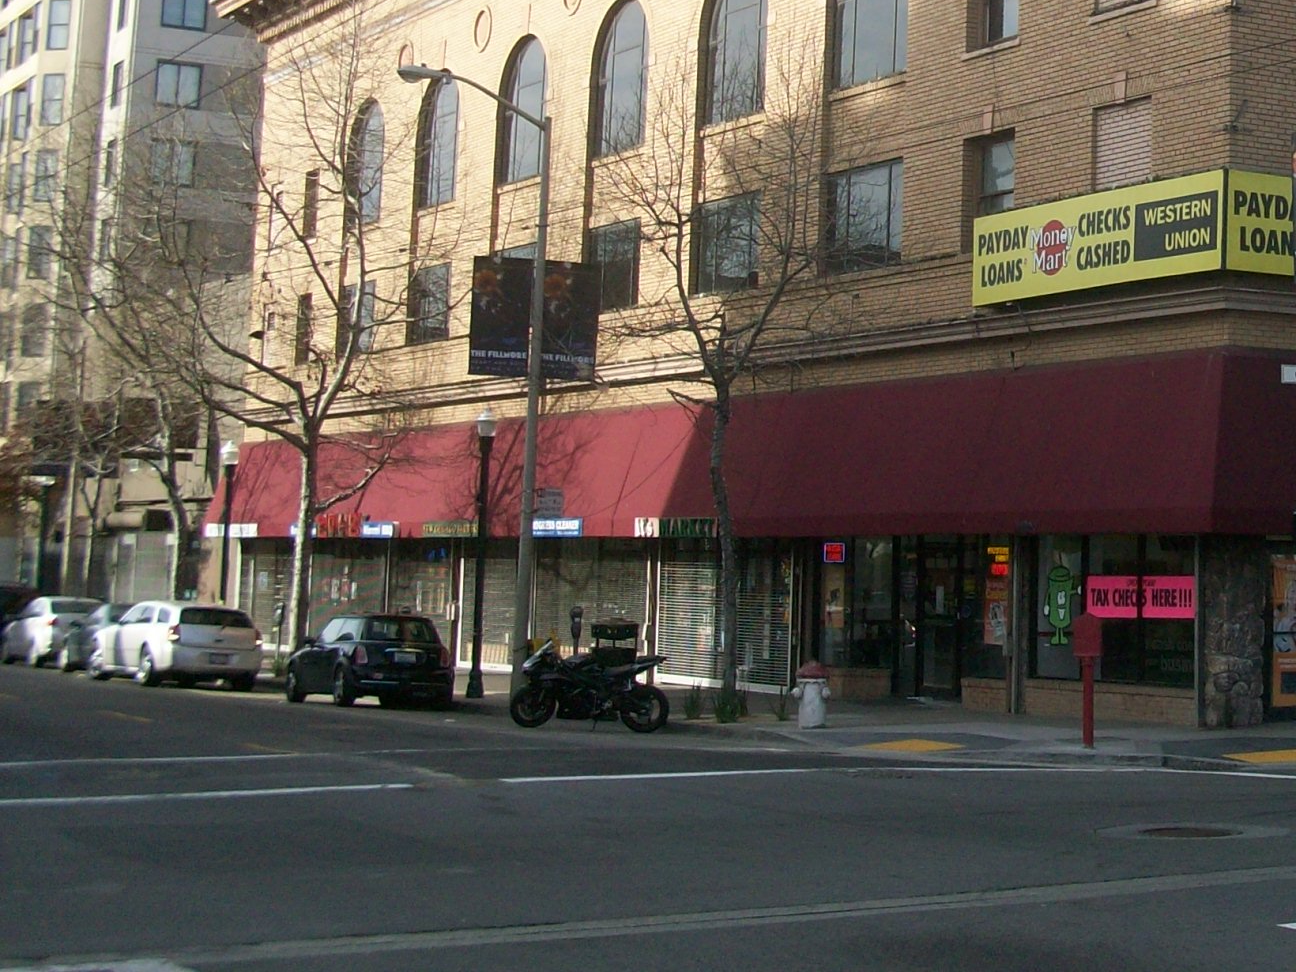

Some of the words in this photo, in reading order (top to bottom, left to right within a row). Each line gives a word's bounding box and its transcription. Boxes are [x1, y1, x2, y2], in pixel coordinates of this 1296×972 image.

[1234, 190, 1294, 221] PAYD
[978, 225, 1029, 257] PAYDAY
[1078, 205, 1131, 238] CHECKS
[1144, 198, 1212, 227] WESTERN
[1030, 225, 1077, 251] Money
[1076, 239, 1131, 271] CASHED
[1164, 227, 1211, 253] UNION
[1240, 226, 1294, 257] LOAN
[1032, 247, 1069, 274] Mart
[471, 349, 486, 358] THE
[487, 349, 527, 359] FILLMORE
[660, 518, 713, 537] MARKET
[1091, 588, 1111, 608] TAX
[1112, 588, 1147, 608] CHECS
[1151, 587, 1193, 608] HERE!!!
